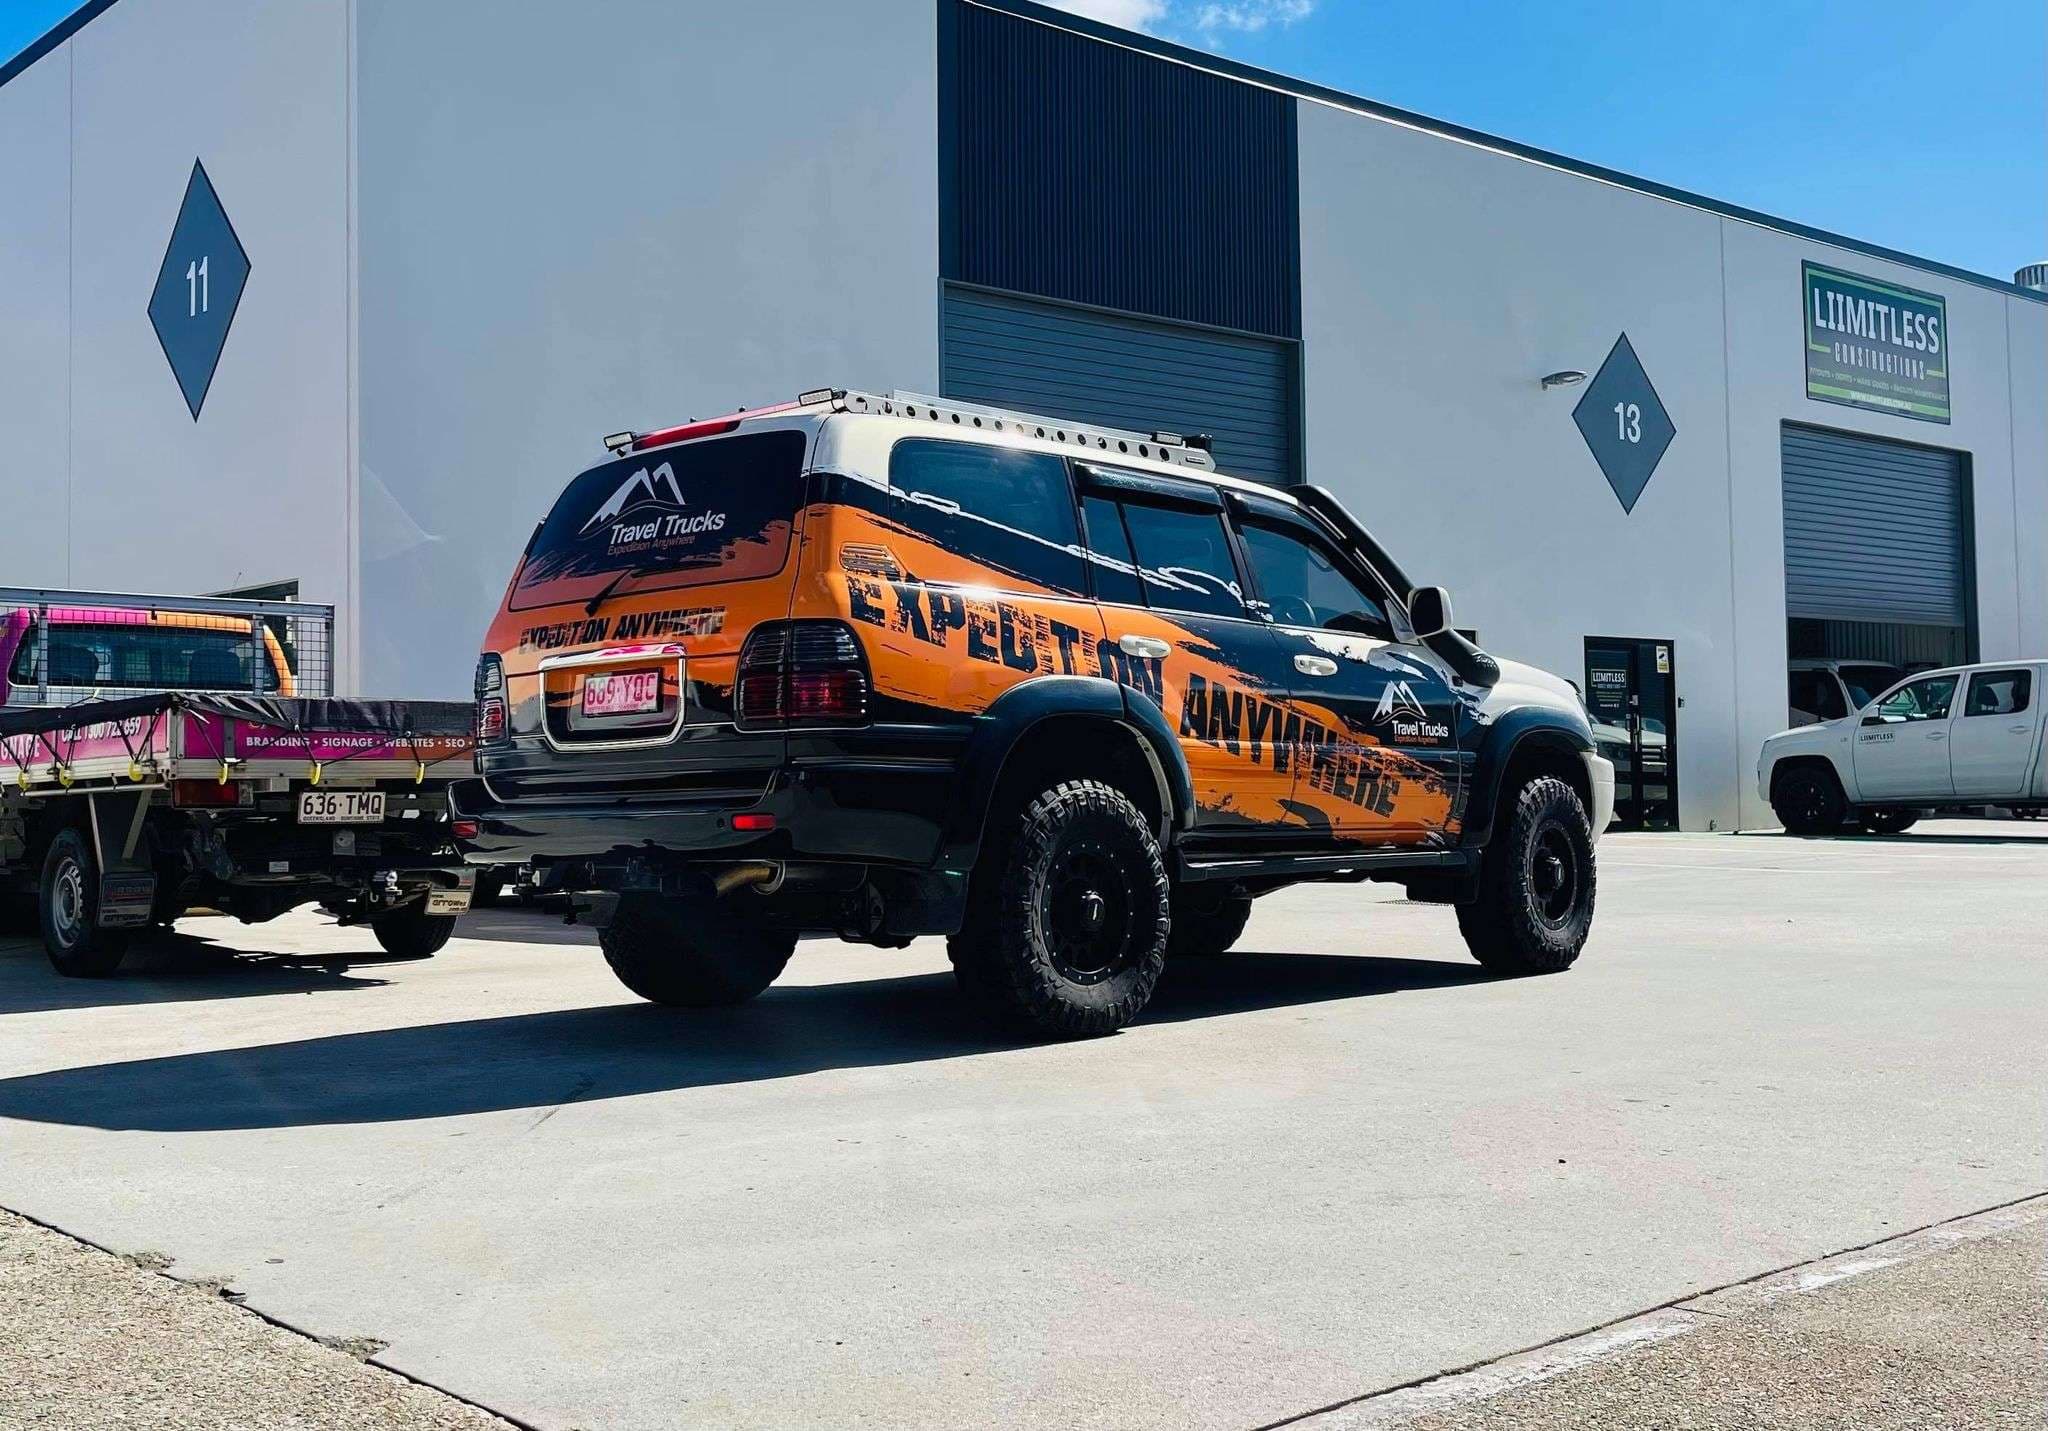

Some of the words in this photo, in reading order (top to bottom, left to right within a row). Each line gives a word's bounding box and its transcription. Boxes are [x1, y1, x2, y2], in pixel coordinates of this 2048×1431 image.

[186, 255, 208, 317] 11
[1813, 287, 1940, 354] LIIMITLESS
[1834, 341, 1925, 381] CONSTRUCTIONS
[1613, 402, 1641, 444] 13
[609, 516, 661, 545] Travel
[664, 510, 726, 536] Trucks
[518, 616, 612, 654] EXPEDITION
[612, 606, 727, 642] ANYWHERE
[846, 572, 1166, 714] EXPEDITION
[1180, 670, 1402, 819] ANYWHERE
[122, 715, 142, 736] 659
[245, 736, 310, 748] BRANDING
[321, 737, 373, 748] SIGNAGE
[444, 738, 466, 748] SEO
[1391, 719, 1419, 737] Travel
[1419, 720, 1449, 738] Trucks
